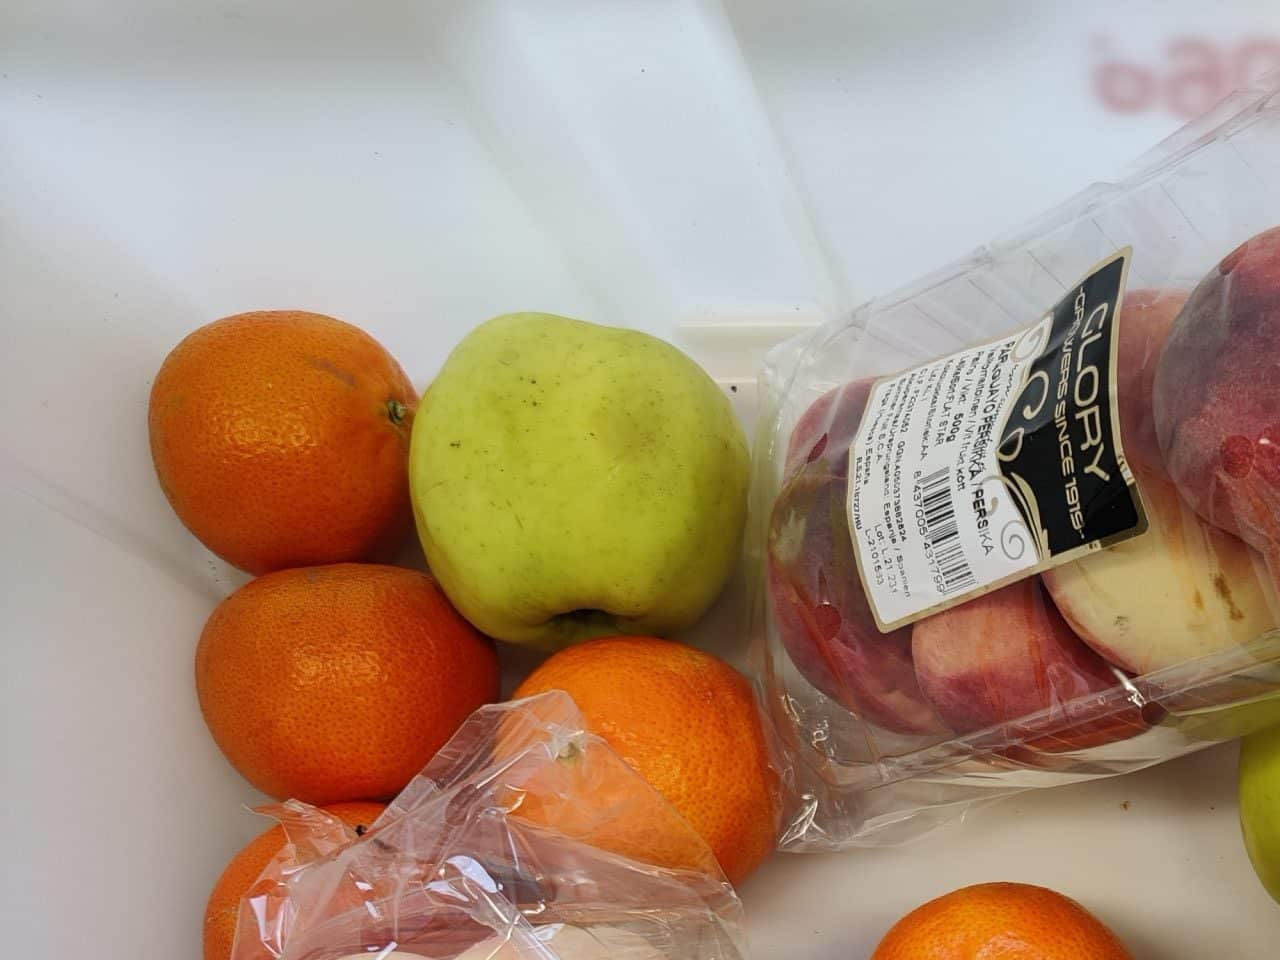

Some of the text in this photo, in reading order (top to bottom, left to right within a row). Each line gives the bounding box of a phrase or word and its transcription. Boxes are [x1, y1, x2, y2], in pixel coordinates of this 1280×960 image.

[945, 412, 965, 443] 500g
[1074, 302, 1110, 481] GLORY
[934, 420, 949, 447] STAR
[1054, 401, 1075, 477] SINCE
[912, 484, 927, 536] 437005
[922, 542, 946, 594] 431799
[971, 489, 995, 557] PERSIKA
